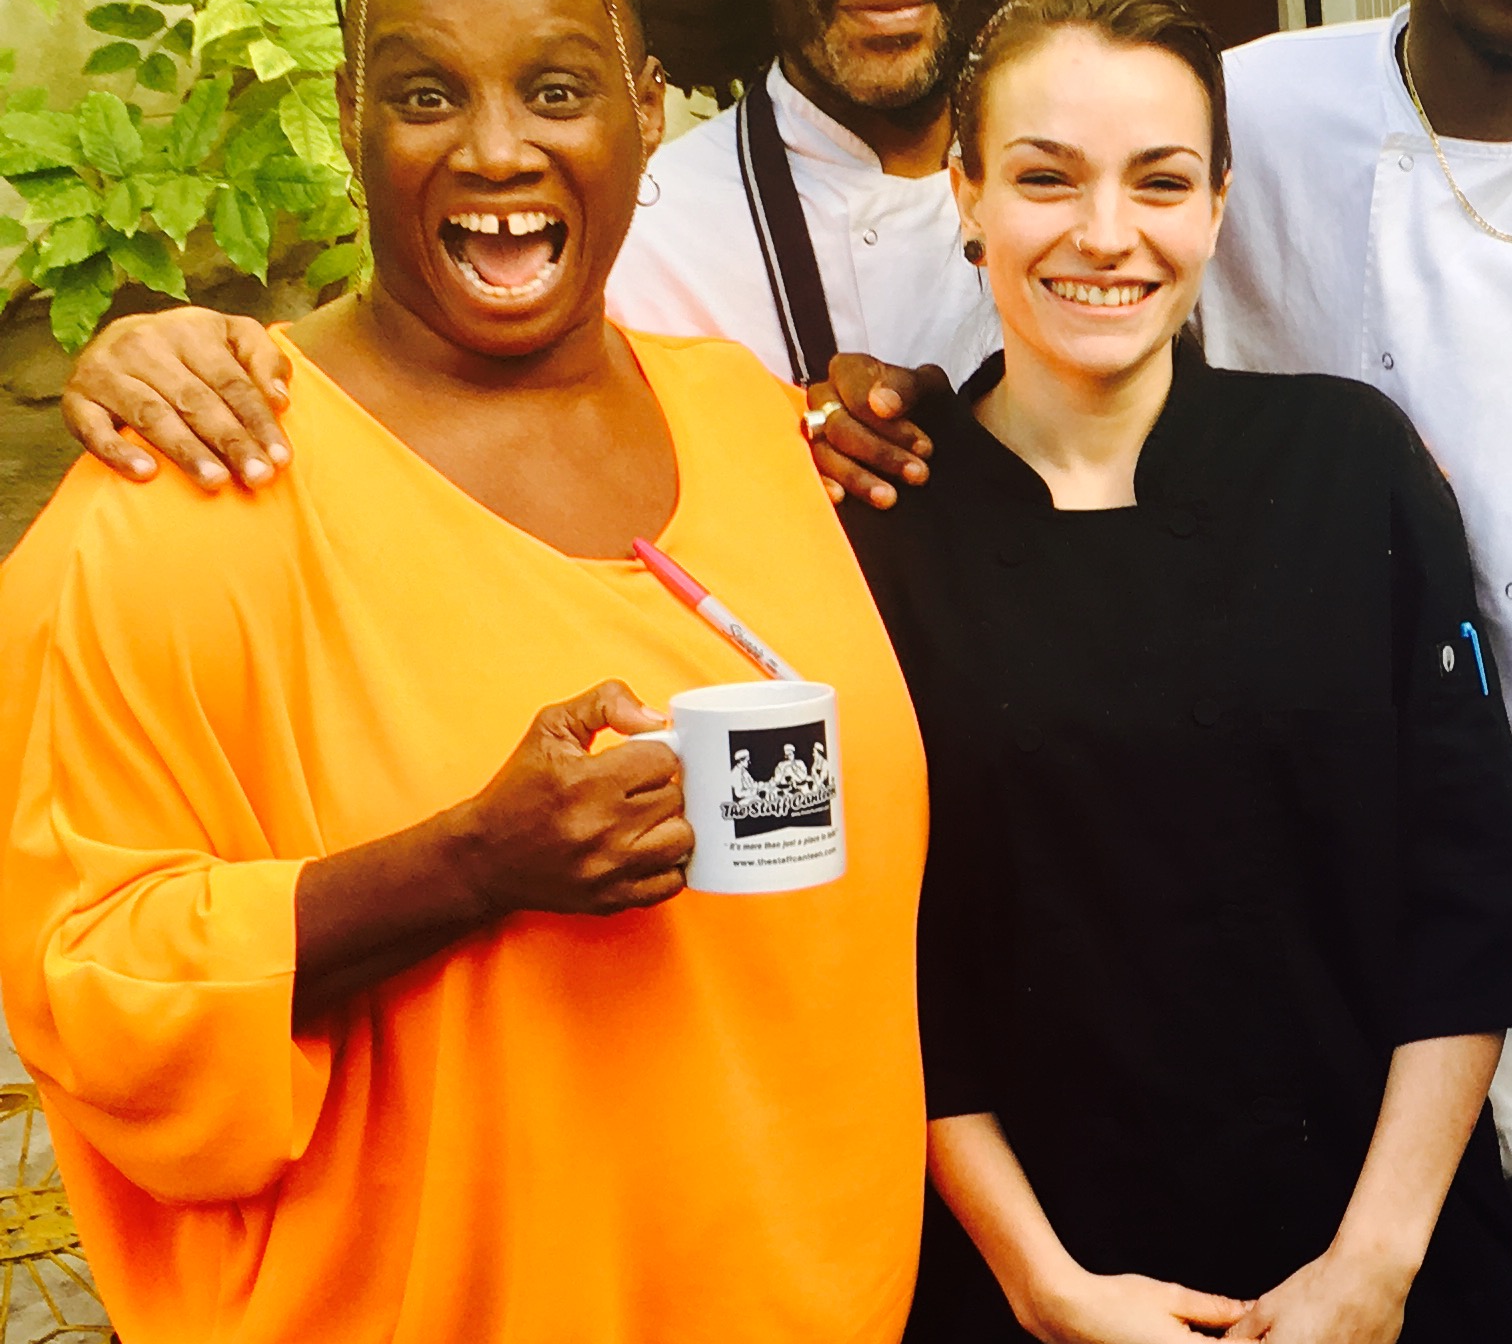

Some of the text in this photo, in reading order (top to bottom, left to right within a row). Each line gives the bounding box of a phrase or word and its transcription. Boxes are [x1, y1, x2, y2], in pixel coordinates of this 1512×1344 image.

[721, 801, 749, 820] The
[749, 797, 790, 817] Staff
[743, 842, 762, 850] more
[764, 840, 781, 849] than
[782, 839, 796, 849] just
[803, 834, 820, 846] place
[733, 847, 837, 866] www.thestaffcanteen.com
